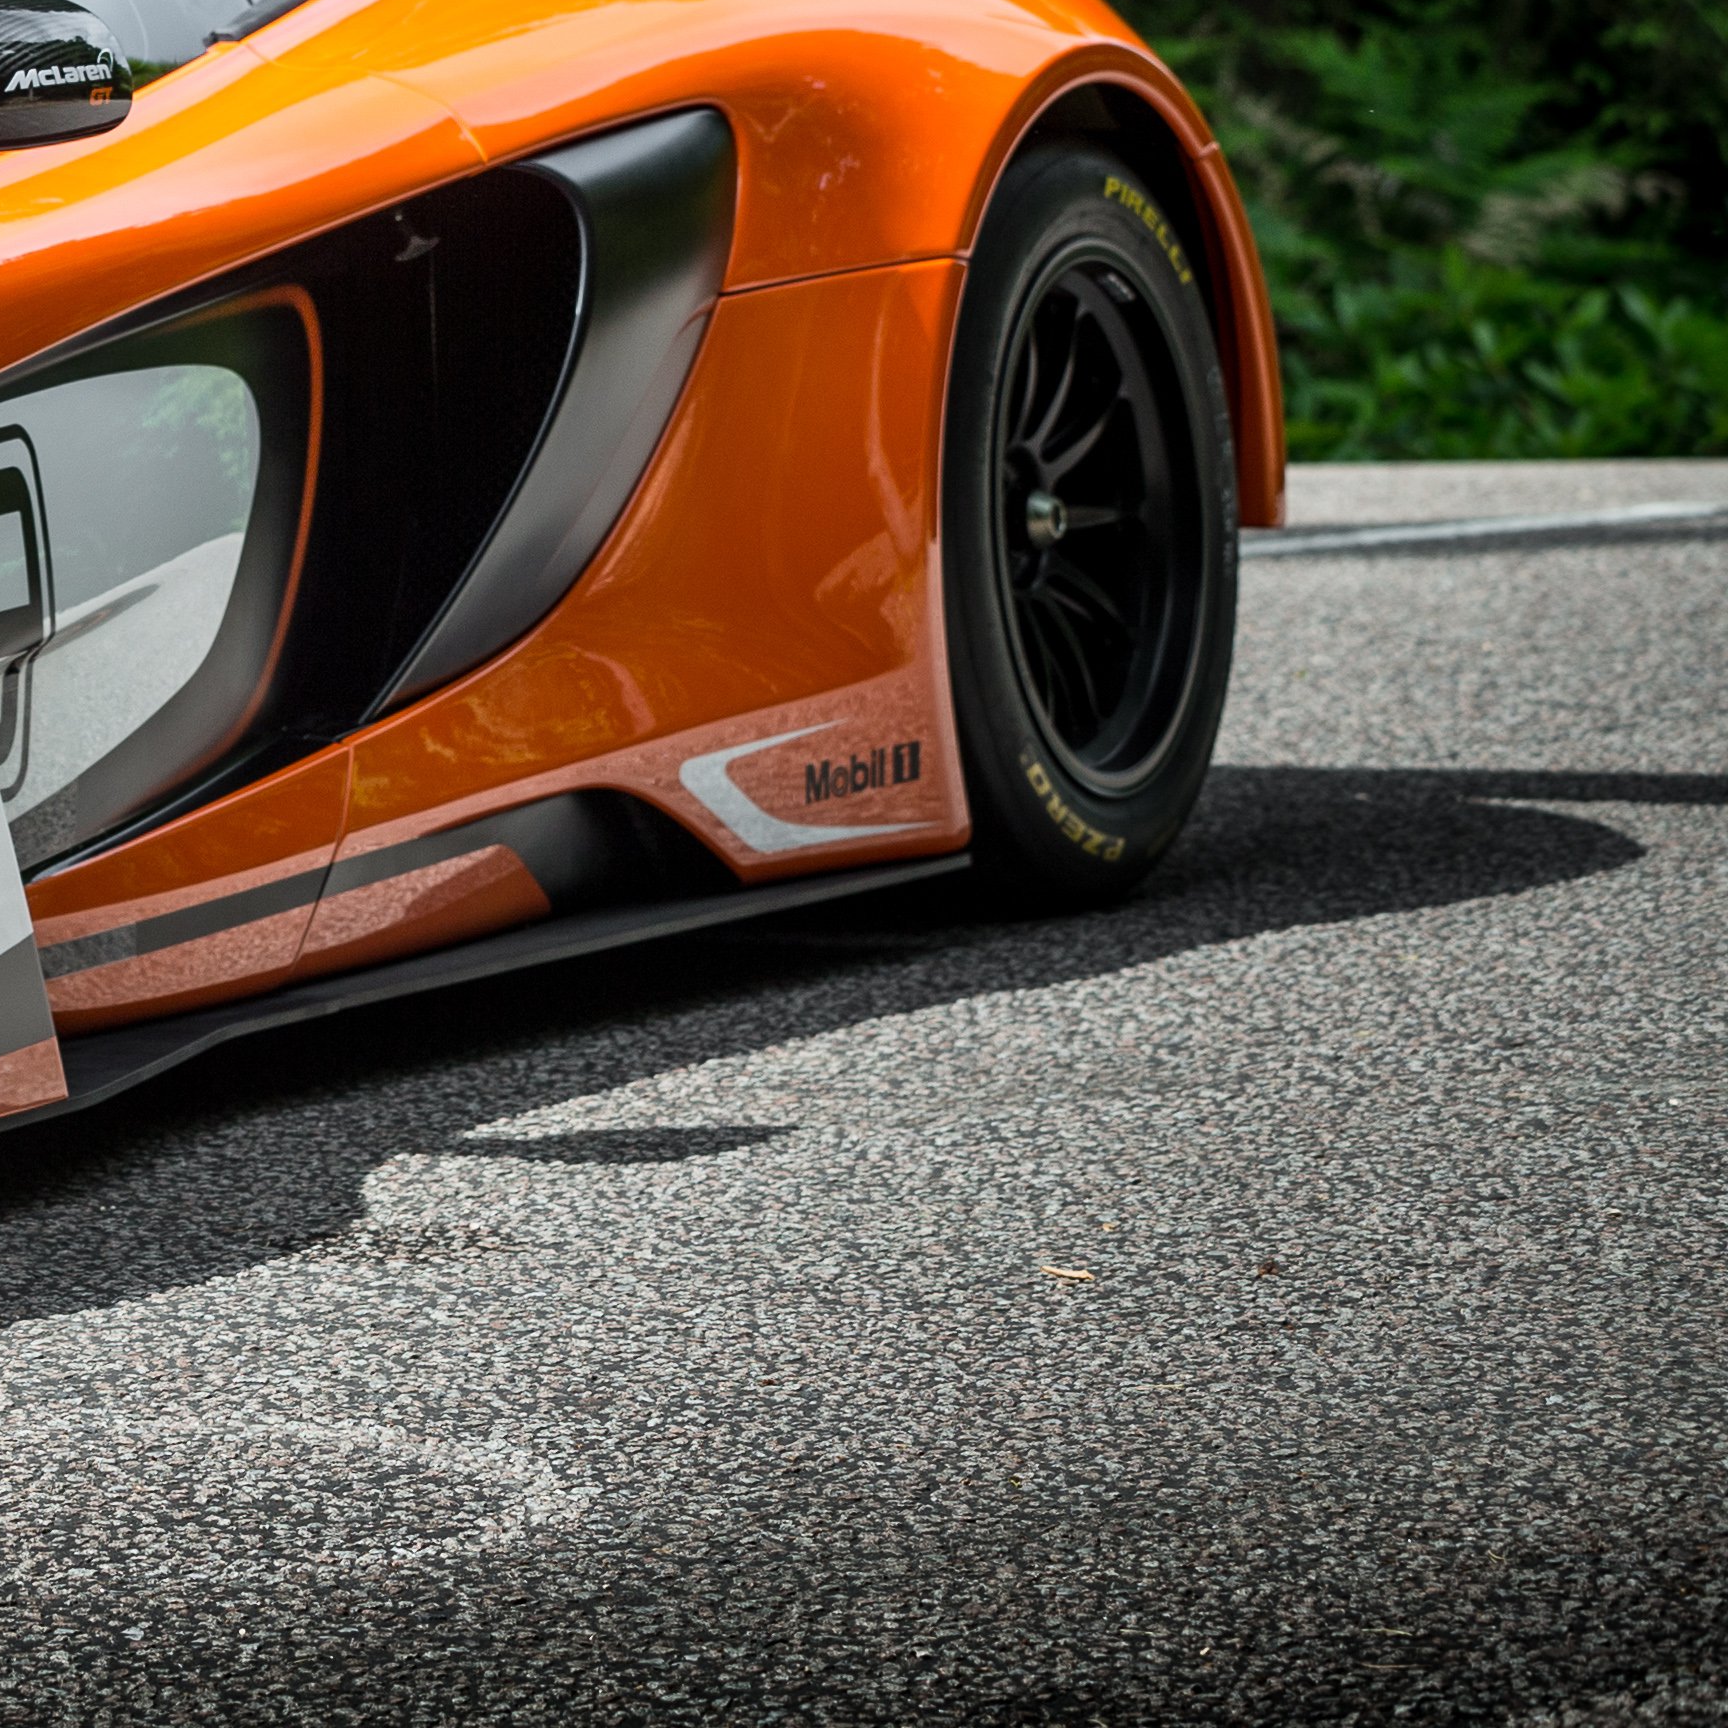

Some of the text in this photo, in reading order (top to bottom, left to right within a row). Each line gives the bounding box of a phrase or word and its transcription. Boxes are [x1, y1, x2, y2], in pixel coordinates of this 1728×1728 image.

[4, 62, 112, 92] McLaren
[91, 86, 113, 106] GT
[1103, 175, 1194, 286] PIRELLI
[805, 742, 919, 804] Mobil 1
